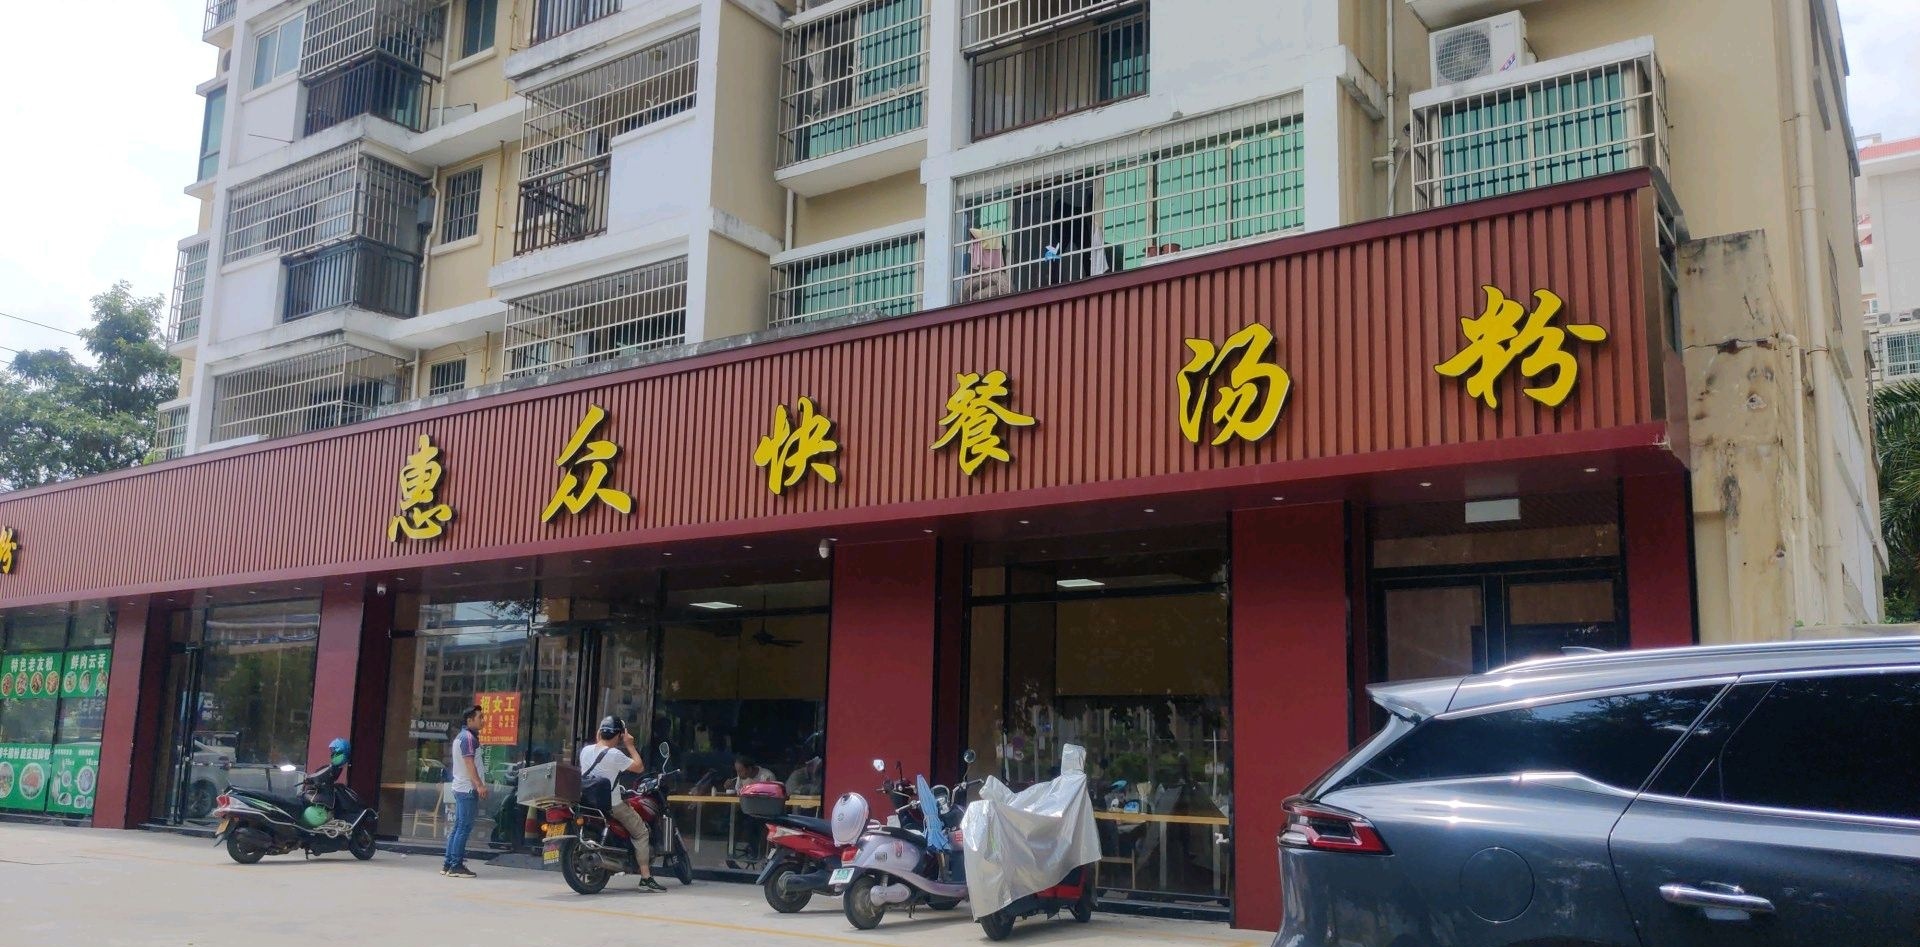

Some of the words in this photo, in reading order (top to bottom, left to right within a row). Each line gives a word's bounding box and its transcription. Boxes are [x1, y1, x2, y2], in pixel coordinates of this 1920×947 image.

[388, 285, 1607, 541] 惠众快餐汤粉
[11, 656, 54, 673] 特色老友粉
[70, 653, 107, 670] 鲜肉云吞
